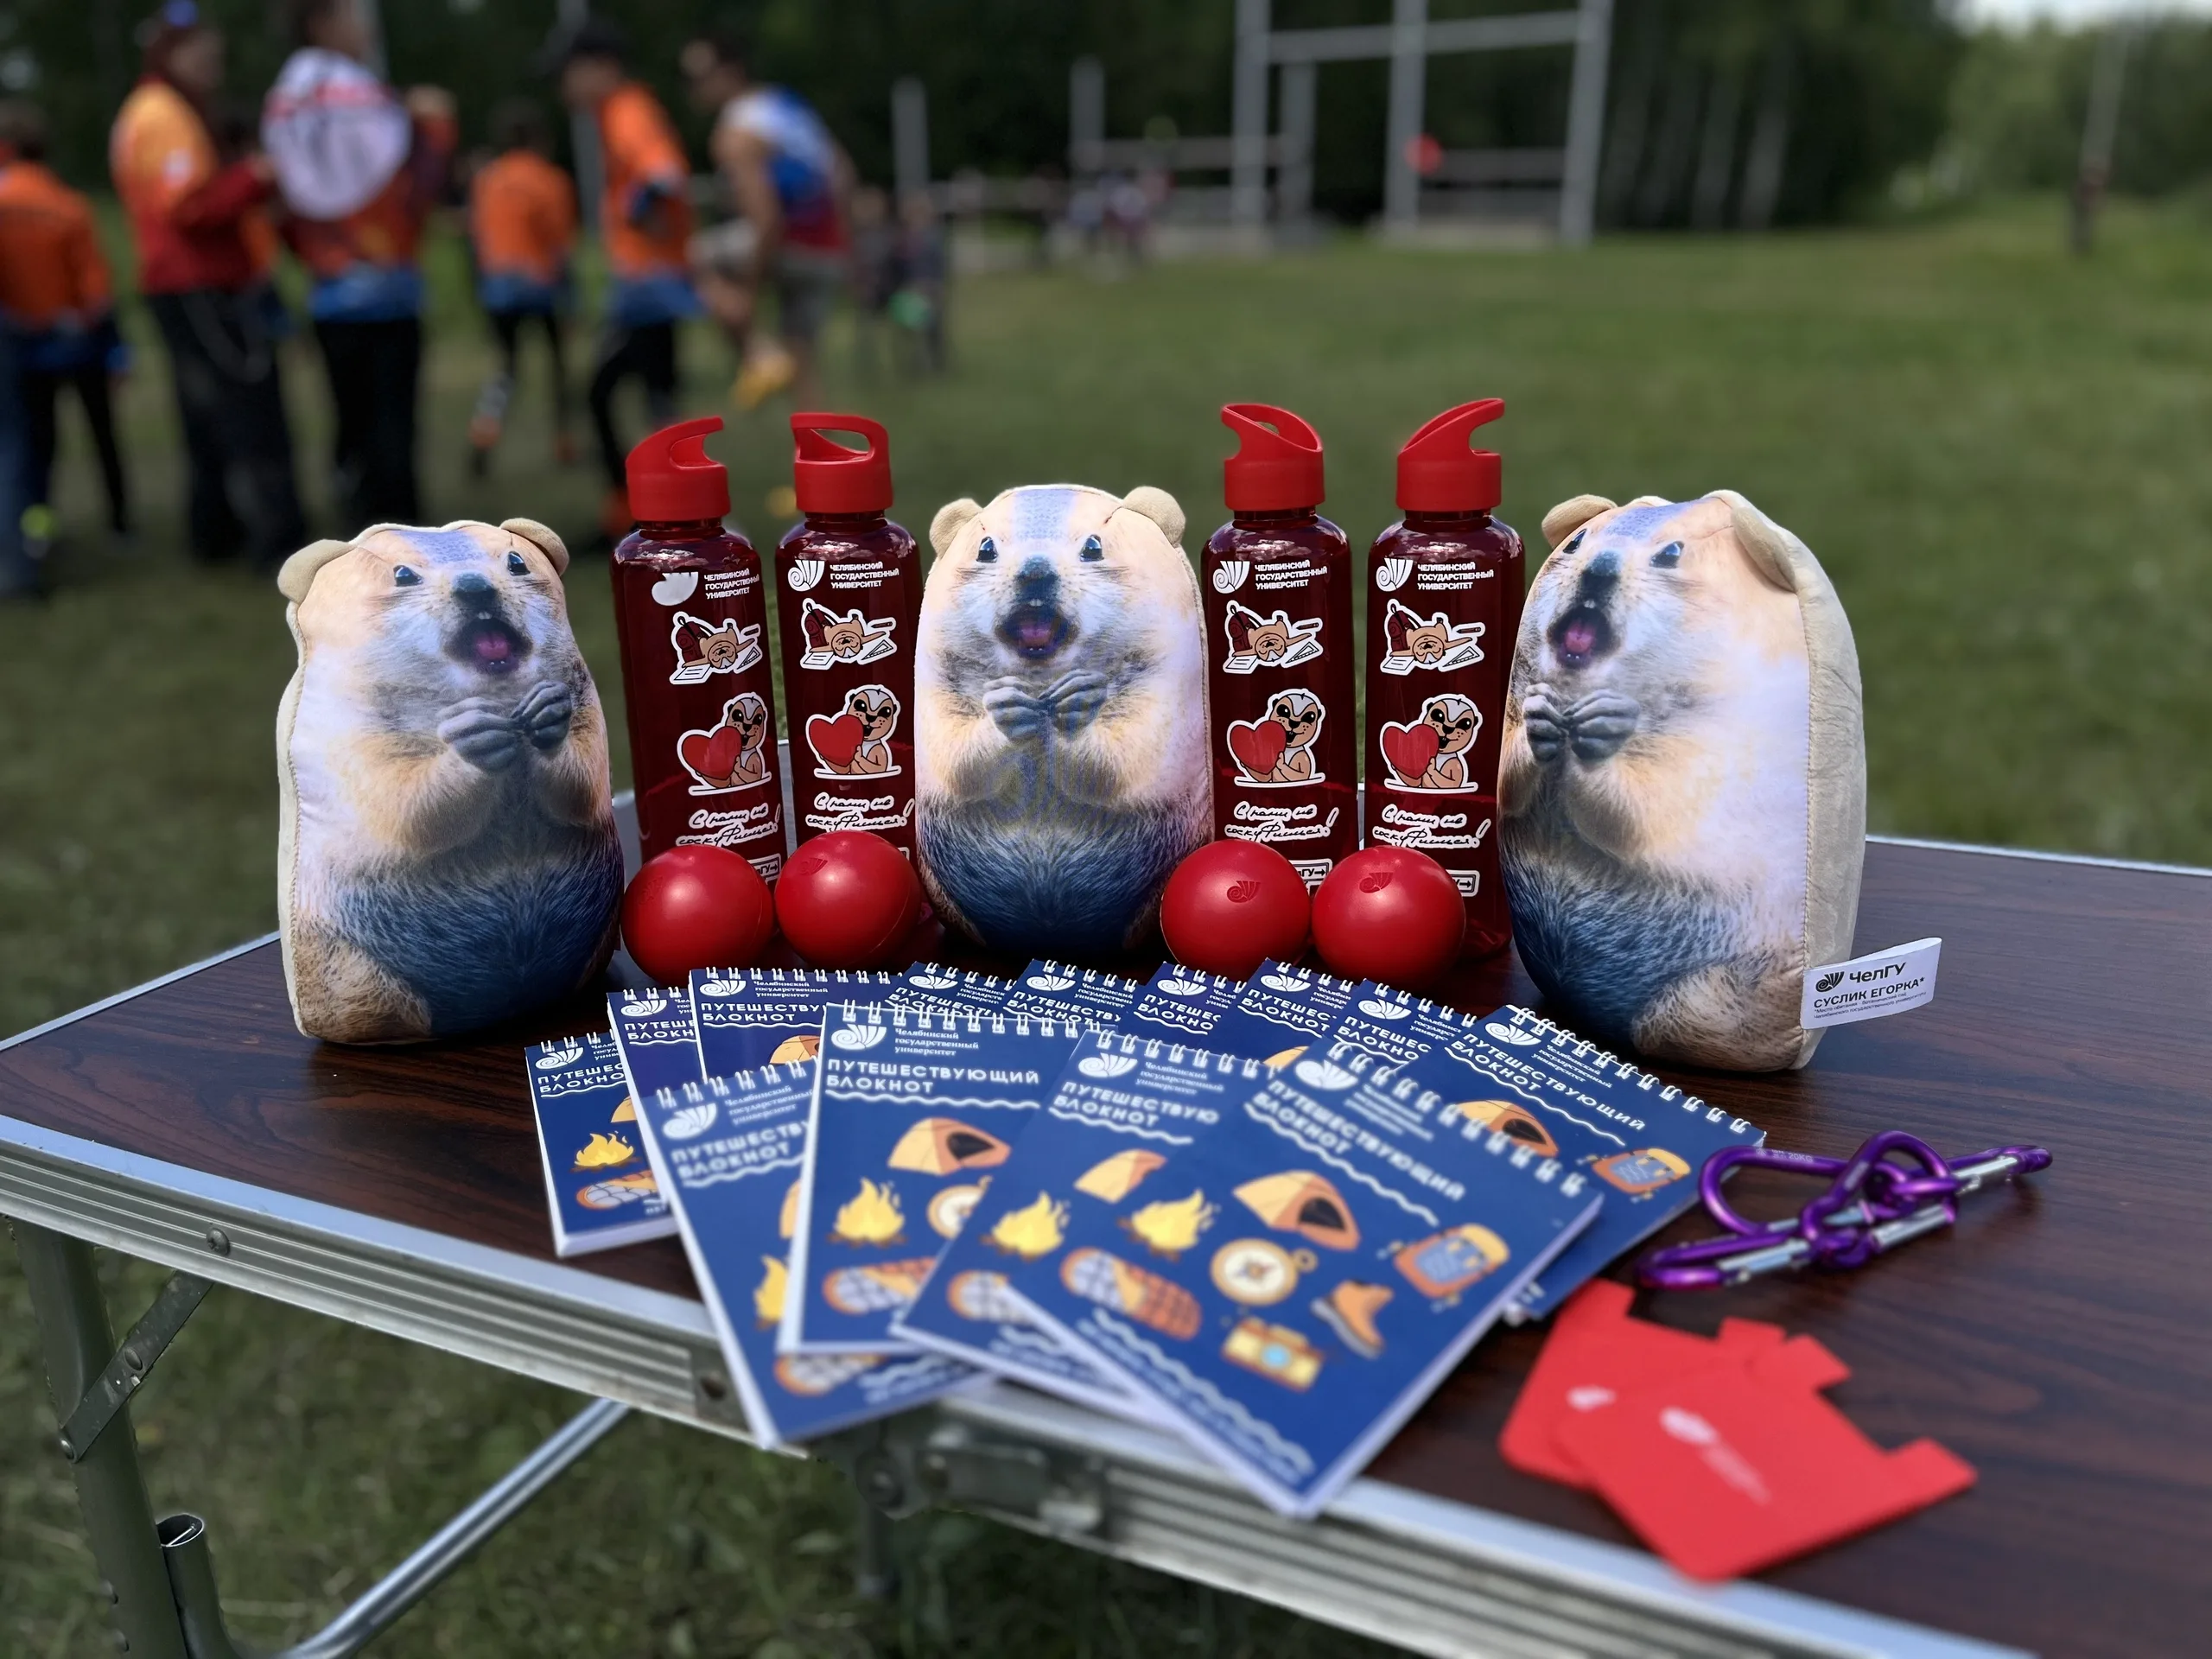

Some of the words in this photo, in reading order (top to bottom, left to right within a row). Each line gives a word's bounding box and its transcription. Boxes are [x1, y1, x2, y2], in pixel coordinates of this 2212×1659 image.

[830, 561, 883, 571] ЧЕЛЯБИНСКИЙ
[1255, 559, 1310, 571] ЧЕЛЯБИНСКИЙ
[1417, 562, 1476, 571] ЧЕЛЯБИНСКИЙ
[704, 568, 750, 582] ЧЕЛЯБИНСКИЙ
[830, 568, 899, 581] ГОСУДАРСТВЕННЫЙ
[1255, 566, 1327, 582] ГОСУДАРСТВЕННЫЙ
[1418, 569, 1494, 582] ГОСУДАРСТВЕННЫЙ
[705, 574, 760, 590] ГОСУДАРСТВЕННЫЙ
[831, 580, 882, 588] УНИВЕРСИТЕТ
[1255, 579, 1309, 590] УНИВЕРСИТЕТ
[1417, 582, 1473, 590] УНИВЕРСИТЕТ
[705, 587, 750, 600] УНИВЕРСИТЕТ
[1849, 962, 1906, 982] ЧелГУ
[1248, 988, 1337, 1020] ПУТЕШЕС
[1814, 990, 1867, 1008] СУСЛИК
[701, 1002, 826, 1012] ПУТЕШЕСТВУ
[1241, 997, 1330, 1031] БЛОКНОТ
[702, 1013, 795, 1021] БЛОКНОТ
[894, 1027, 959, 1039] Челябинский
[894, 1037, 979, 1049] государственный
[894, 1046, 957, 1057] университет
[828, 1058, 1039, 1084] ПУТЕШЕСТВУЮЩИЙ
[1451, 1040, 1541, 1091] БЛОКНОТ
[826, 1075, 933, 1093] БЛОКНОТ
[1462, 1033, 1646, 1131] ПУТЕШЕСТВУЮЩИЙ
[1053, 1094, 1159, 1127] БЛОКНОТ
[1252, 1091, 1352, 1154] БЛОКНОТ
[1268, 1079, 1465, 1202] ПУТЕШЕСТВУЮЩИЙ
[677, 1141, 790, 1179] БЛОКНОТ
